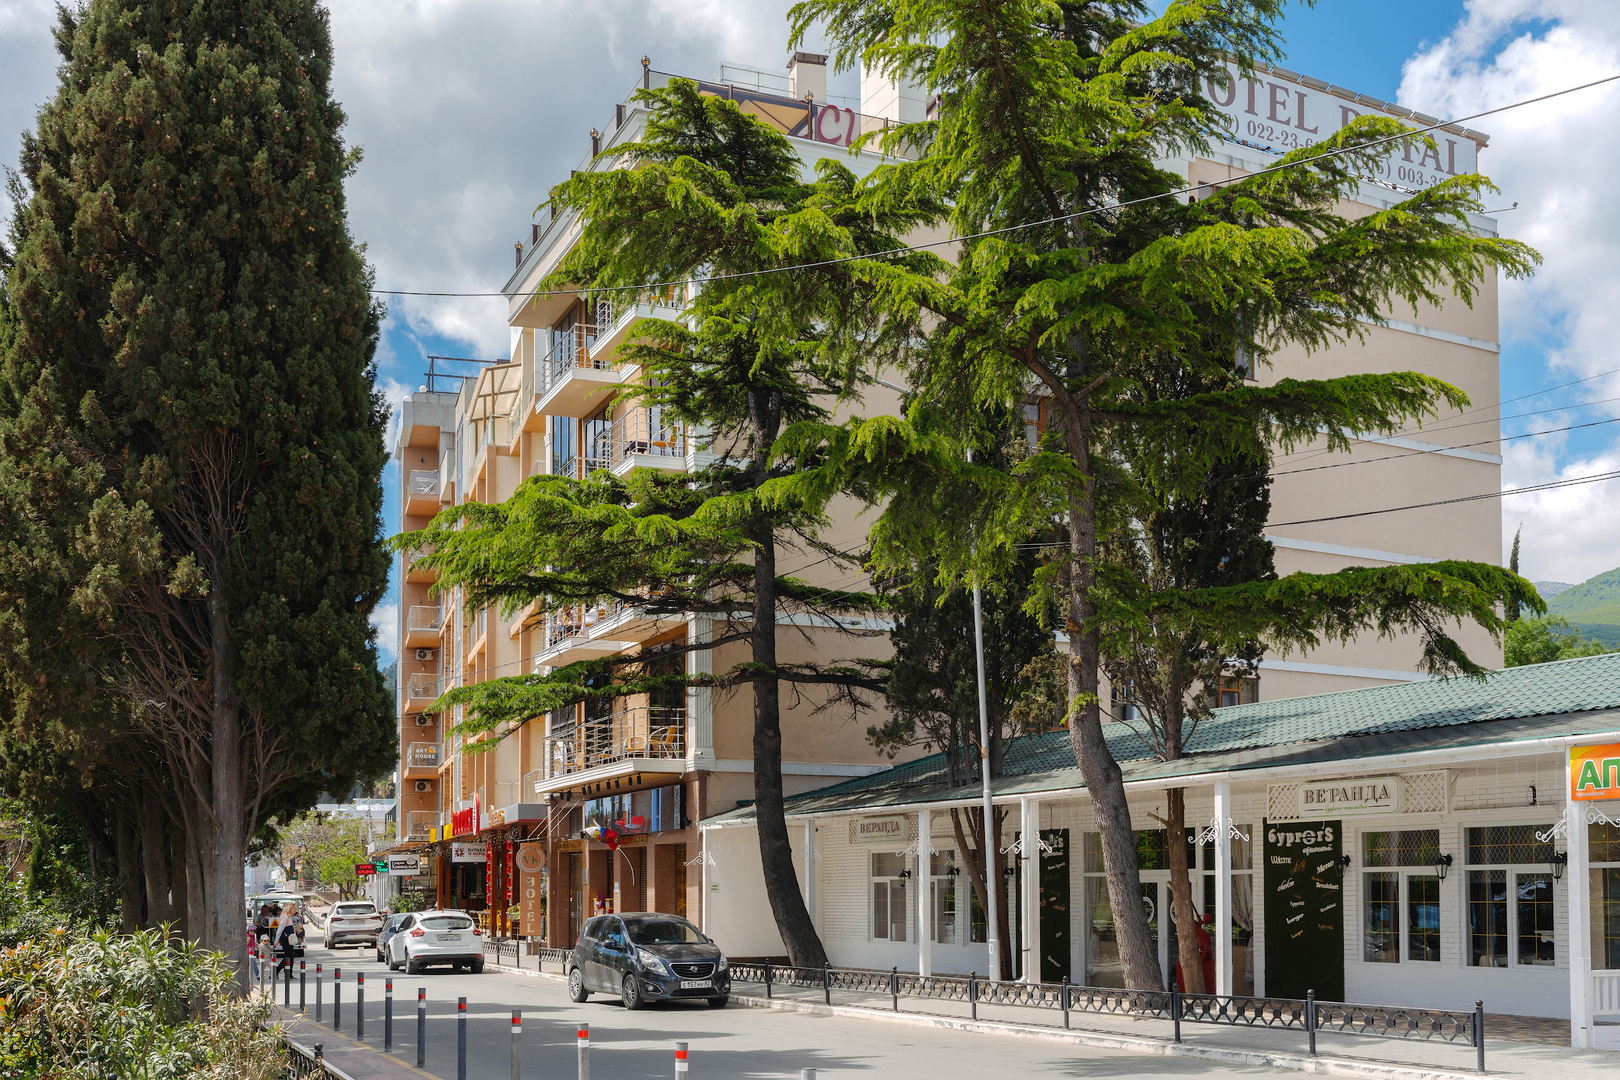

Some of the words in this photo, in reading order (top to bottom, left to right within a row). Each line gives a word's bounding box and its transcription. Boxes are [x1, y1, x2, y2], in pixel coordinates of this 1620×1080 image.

[1197, 65, 1319, 135] OTEL
[1247, 120, 1318, 148] 022-23-6
[1304, 785, 1390, 804] ВЕРАНДА
[860, 821, 899, 834] ВЕРАНДА
[523, 855, 539, 865] VK
[525, 877, 536, 933] HOTEL
